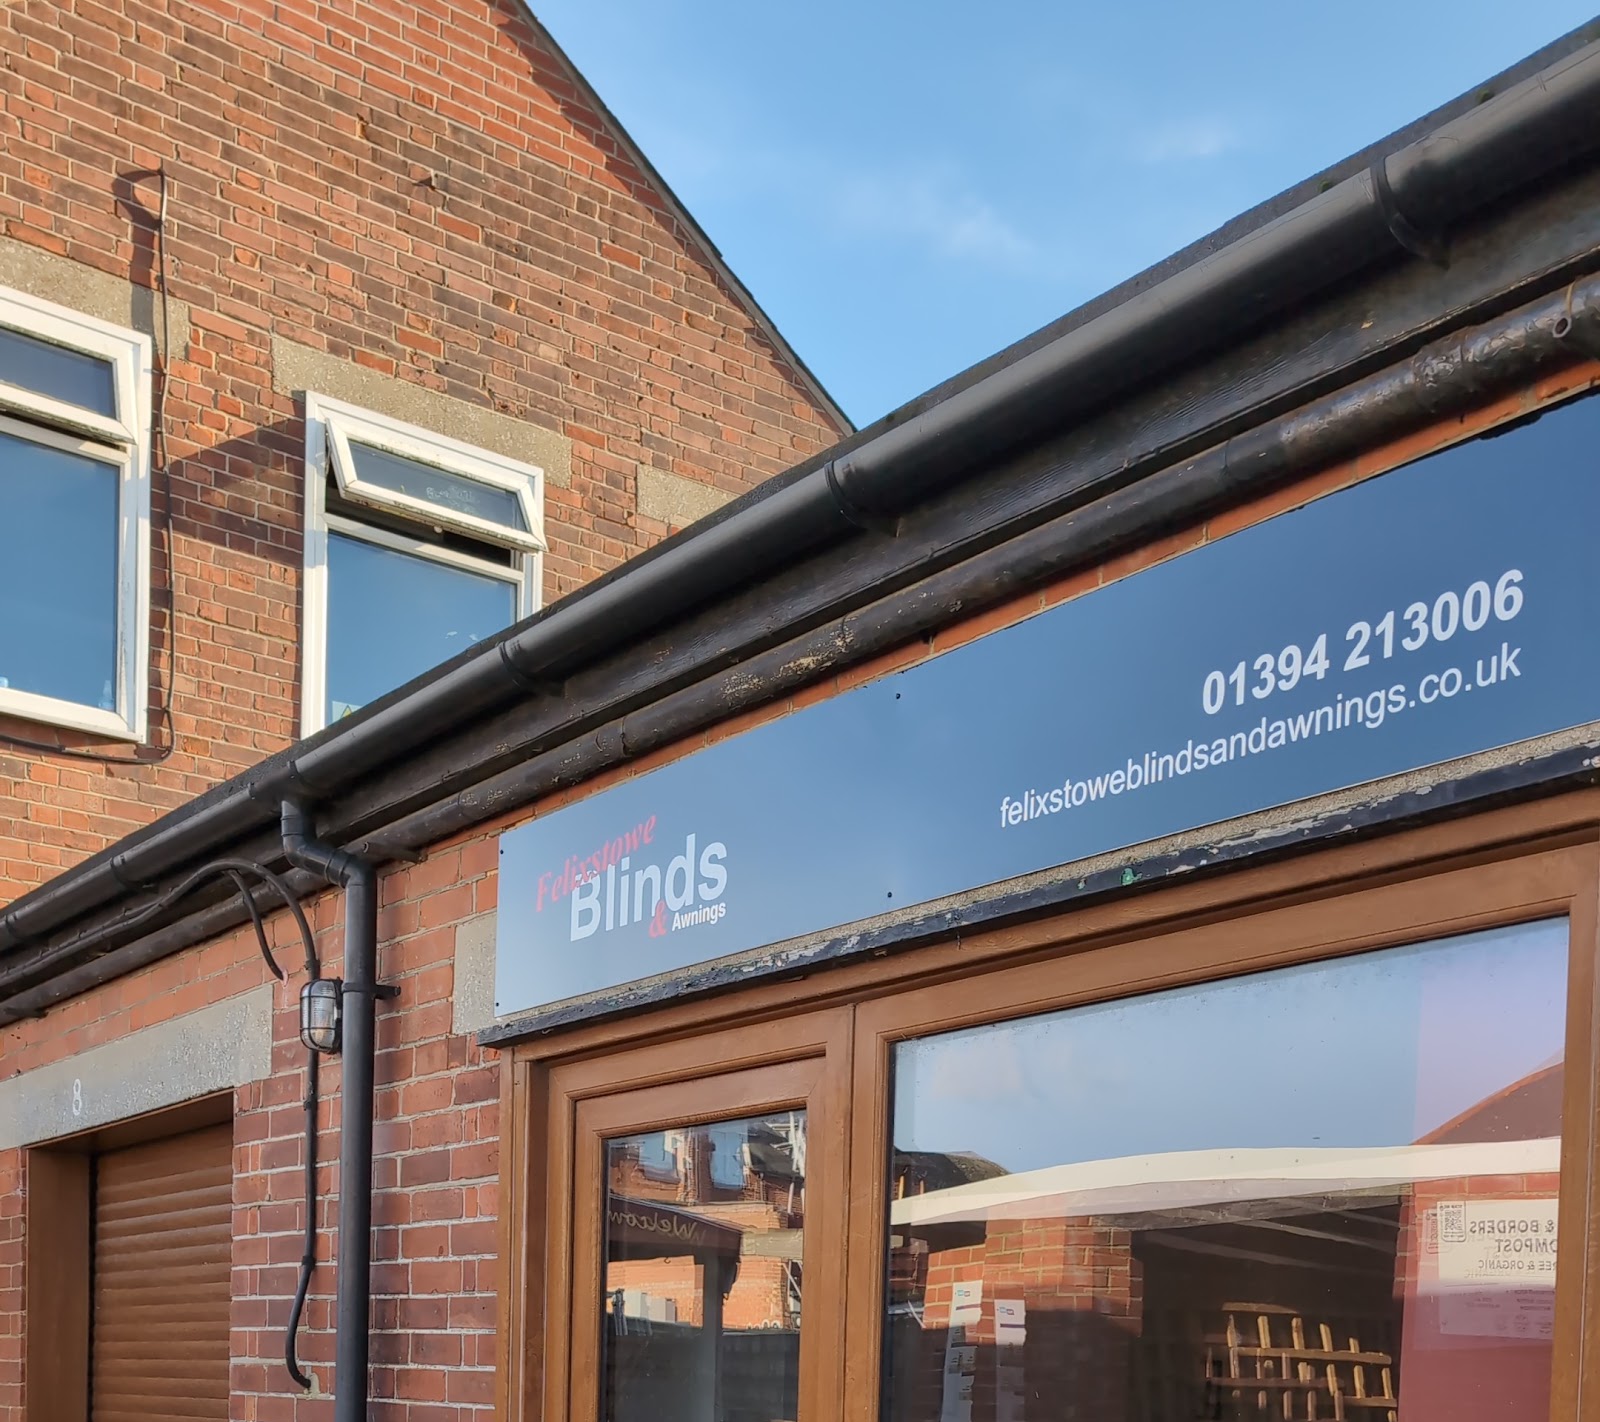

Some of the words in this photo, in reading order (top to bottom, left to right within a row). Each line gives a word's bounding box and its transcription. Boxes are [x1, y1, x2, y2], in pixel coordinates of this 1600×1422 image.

[1202, 635, 1329, 715] 01394
[1343, 569, 1524, 672] 213006
[1000, 642, 1523, 829] felixstoweblindsandawnings.co.uk
[536, 815, 657, 913] Felixstowe
[570, 833, 728, 942] Blinds
[648, 900, 668, 938] &
[672, 902, 727, 931] Awnings
[72, 1078, 82, 1116] 8
